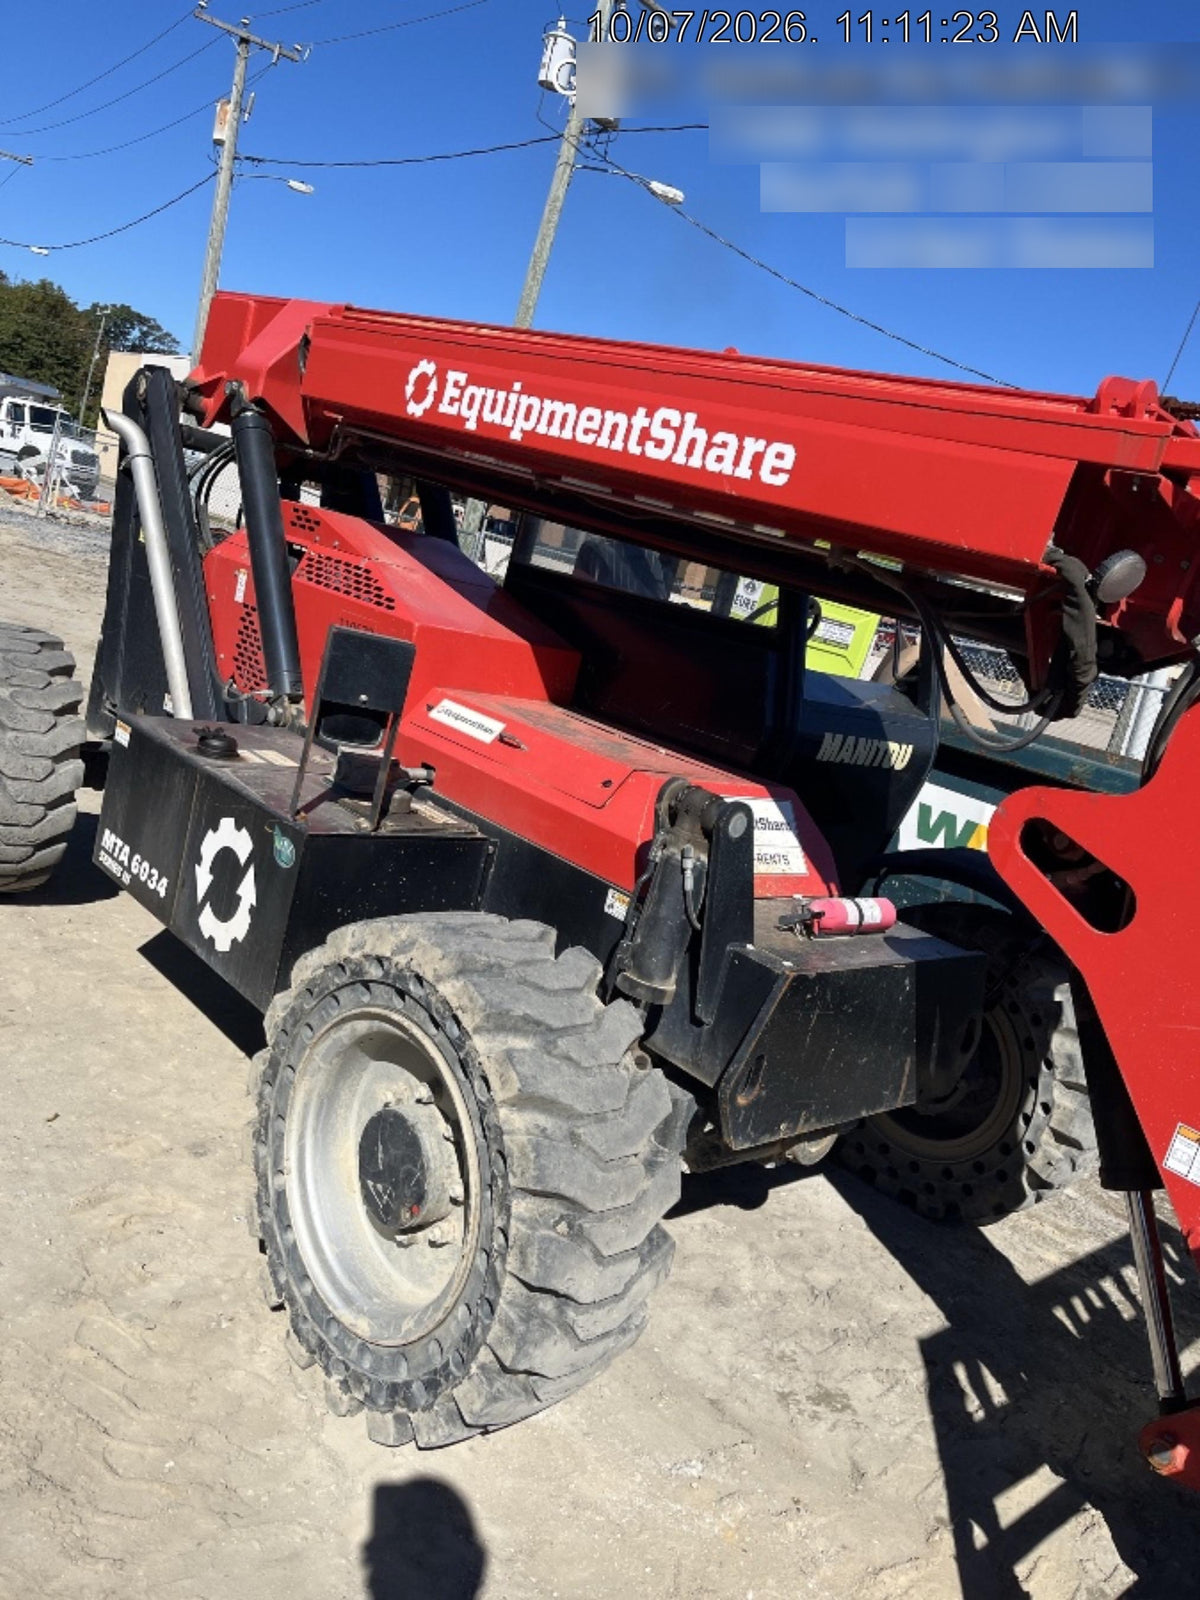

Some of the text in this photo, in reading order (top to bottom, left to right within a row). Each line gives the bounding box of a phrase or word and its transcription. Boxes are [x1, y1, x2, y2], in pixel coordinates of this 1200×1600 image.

[437, 369, 797, 487] EquipmentShare
[816, 732, 913, 770] MANITOU
[101, 828, 169, 899] MTA 6034
